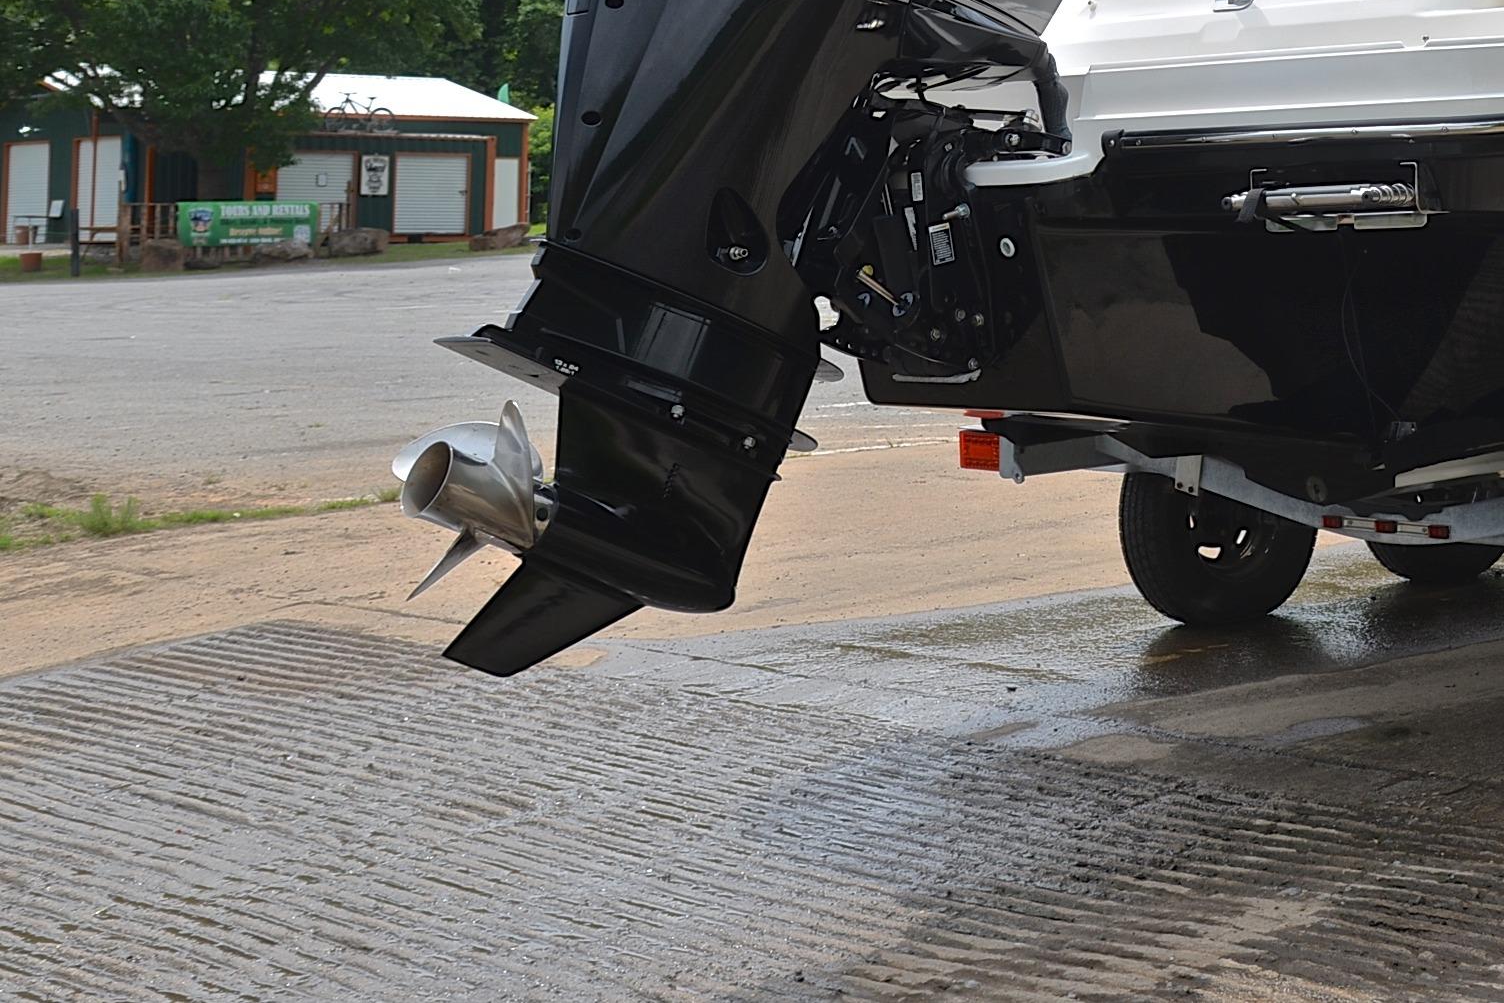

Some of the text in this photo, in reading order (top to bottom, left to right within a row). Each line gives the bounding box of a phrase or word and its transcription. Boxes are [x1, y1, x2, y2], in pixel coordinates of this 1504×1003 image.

[221, 204, 310, 216] TOURS AND RENTALS
